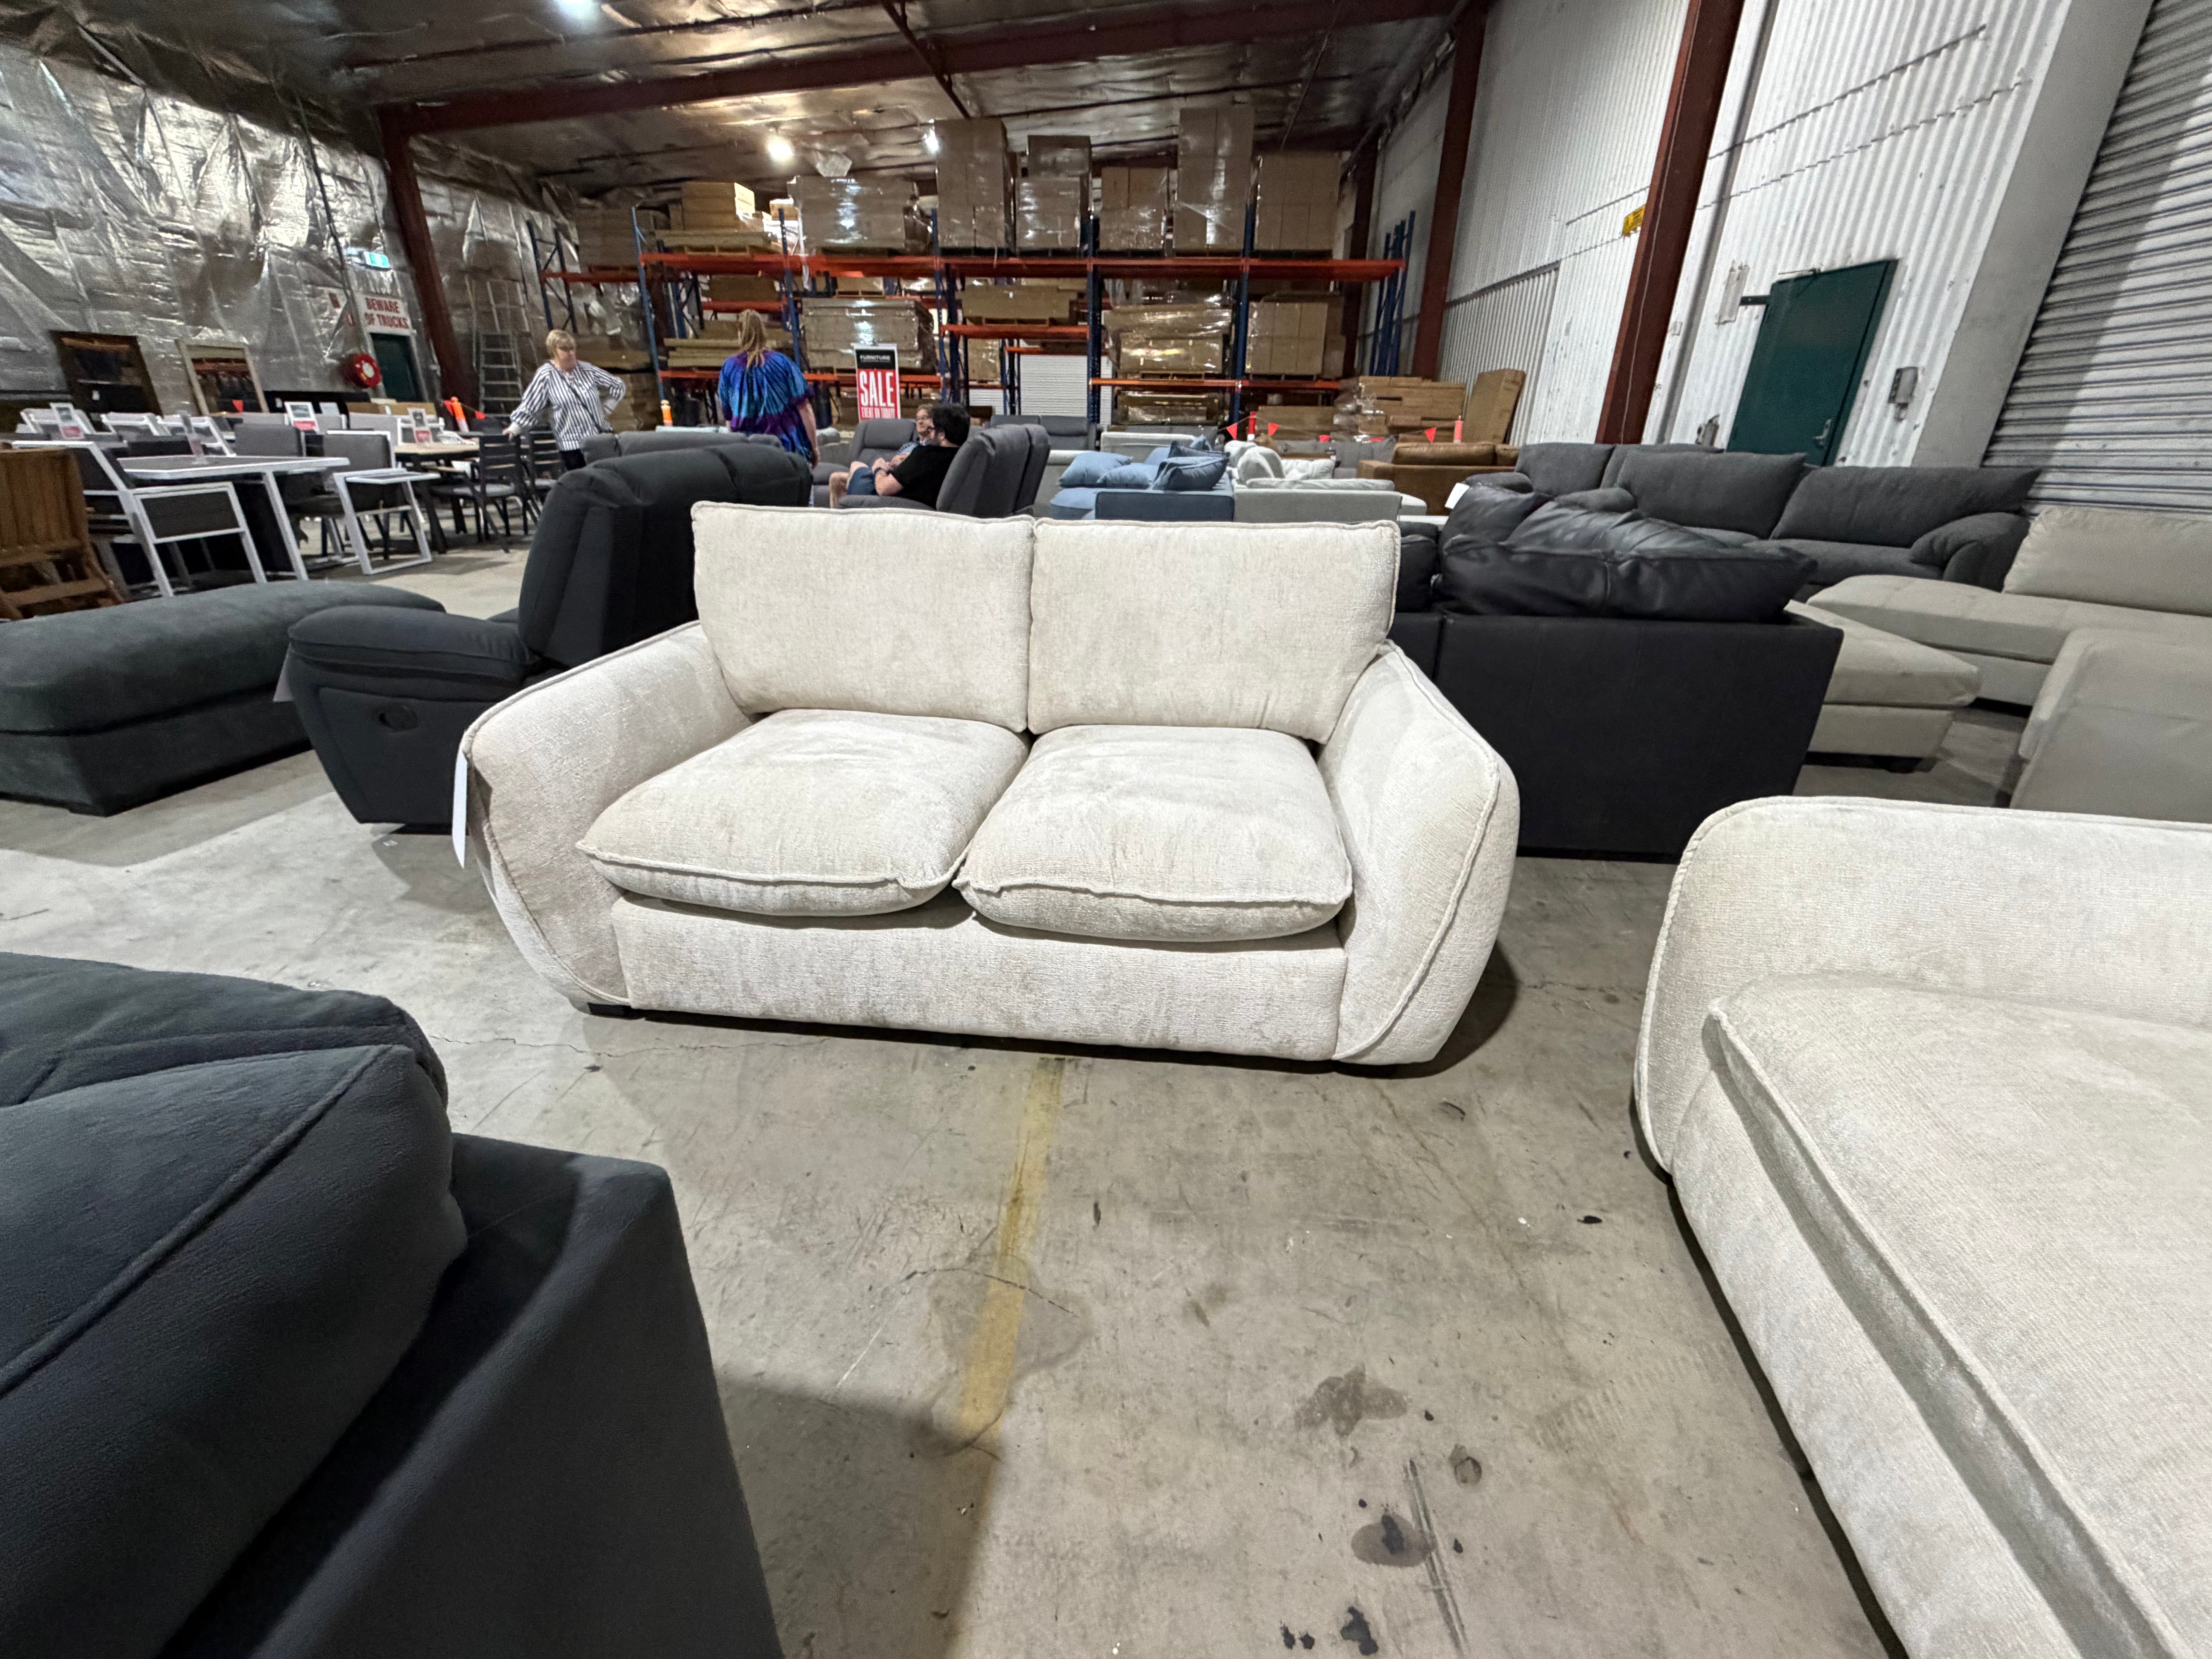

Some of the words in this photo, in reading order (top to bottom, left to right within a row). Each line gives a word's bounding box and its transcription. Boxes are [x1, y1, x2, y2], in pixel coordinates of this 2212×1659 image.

[365, 297, 400, 313] BEWARE
[364, 312, 374, 325] OF
[376, 314, 410, 329] TRUCKS
[859, 371, 895, 407] SALE
